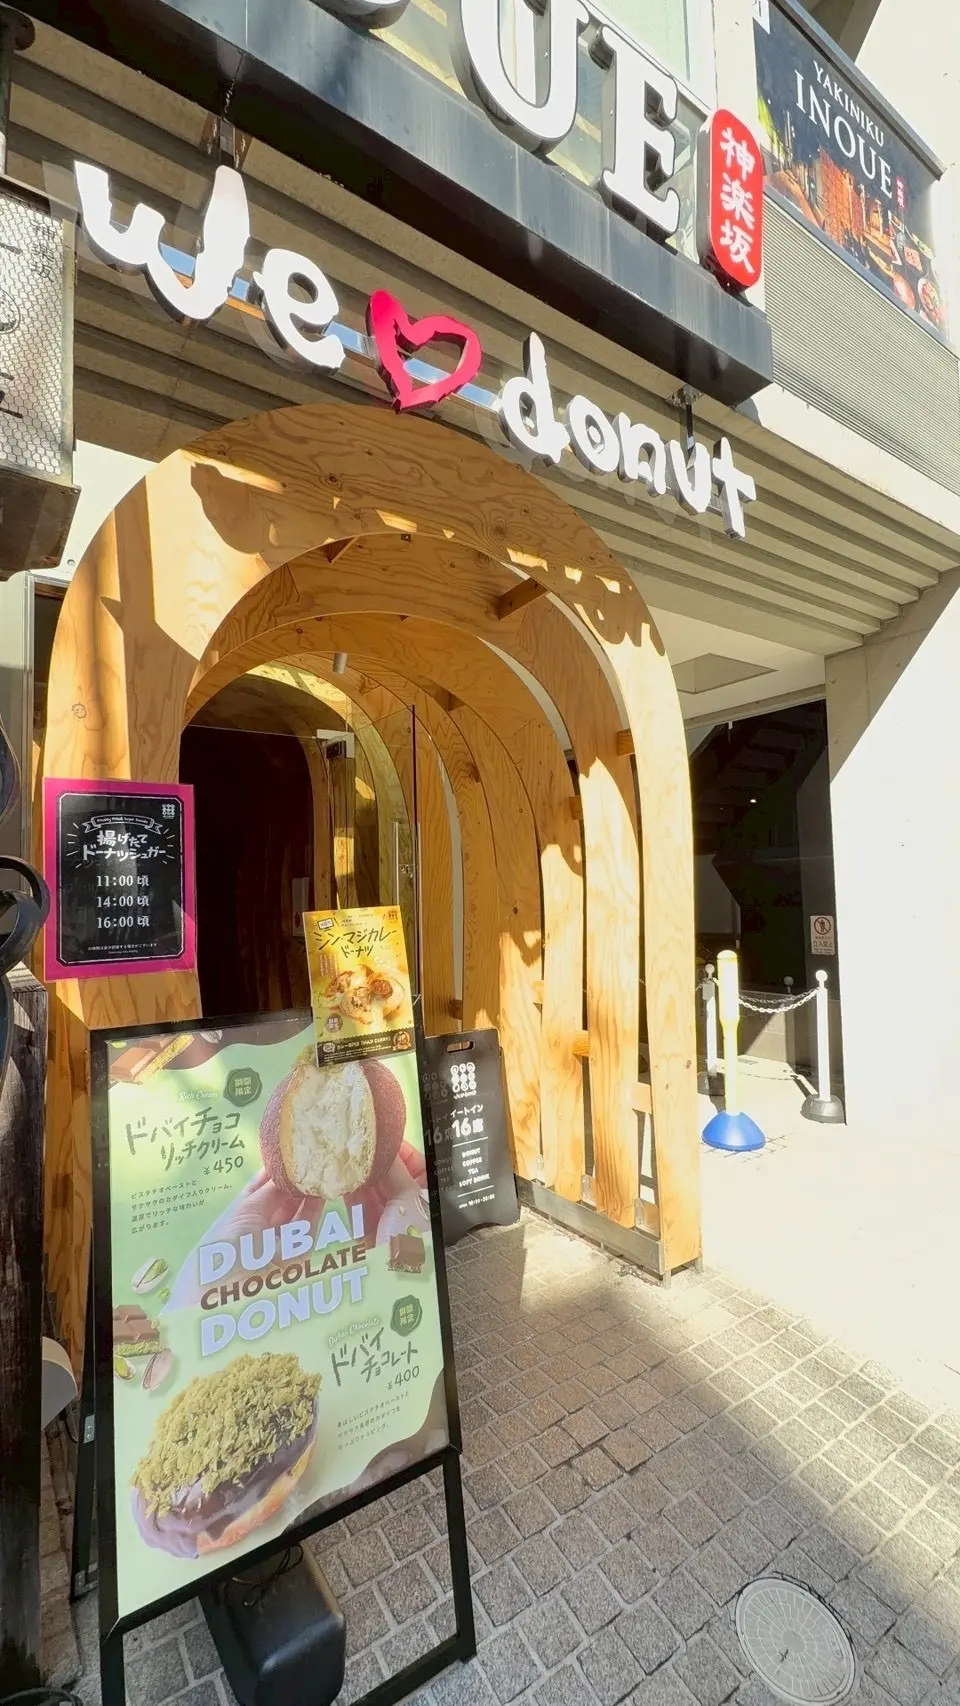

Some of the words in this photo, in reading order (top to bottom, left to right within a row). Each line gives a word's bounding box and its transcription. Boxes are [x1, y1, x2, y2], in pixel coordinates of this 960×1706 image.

[345, 0, 681, 235] UE
[814, 60, 884, 147] YAKINIKU
[795, 70, 893, 199] INOUE
[720, 127, 756, 274] 神楽坂
[500, 332, 757, 540] donut
[97, 830, 148, 847] 揚げたて
[97, 875, 133, 887] 11:00
[137, 875, 150, 887] 頃
[97, 895, 133, 907] 14:00
[137, 895, 150, 907] 頃
[97, 916, 133, 928] 16:00
[137, 916, 150, 928] 頃
[340, 944, 374, 958] ドーナツ
[126, 1107, 240, 1155] ドバイチョコ
[450, 1104, 483, 1117] イートイン
[161, 1134, 245, 1171] リッチクリーム
[200, 1203, 365, 1286] DUBAI
[200, 1243, 367, 1310] CHOCOLATE
[201, 1266, 368, 1357] DONUT
[332, 1327, 384, 1387] ドバイ
[361, 1341, 418, 1383] チョコレート
